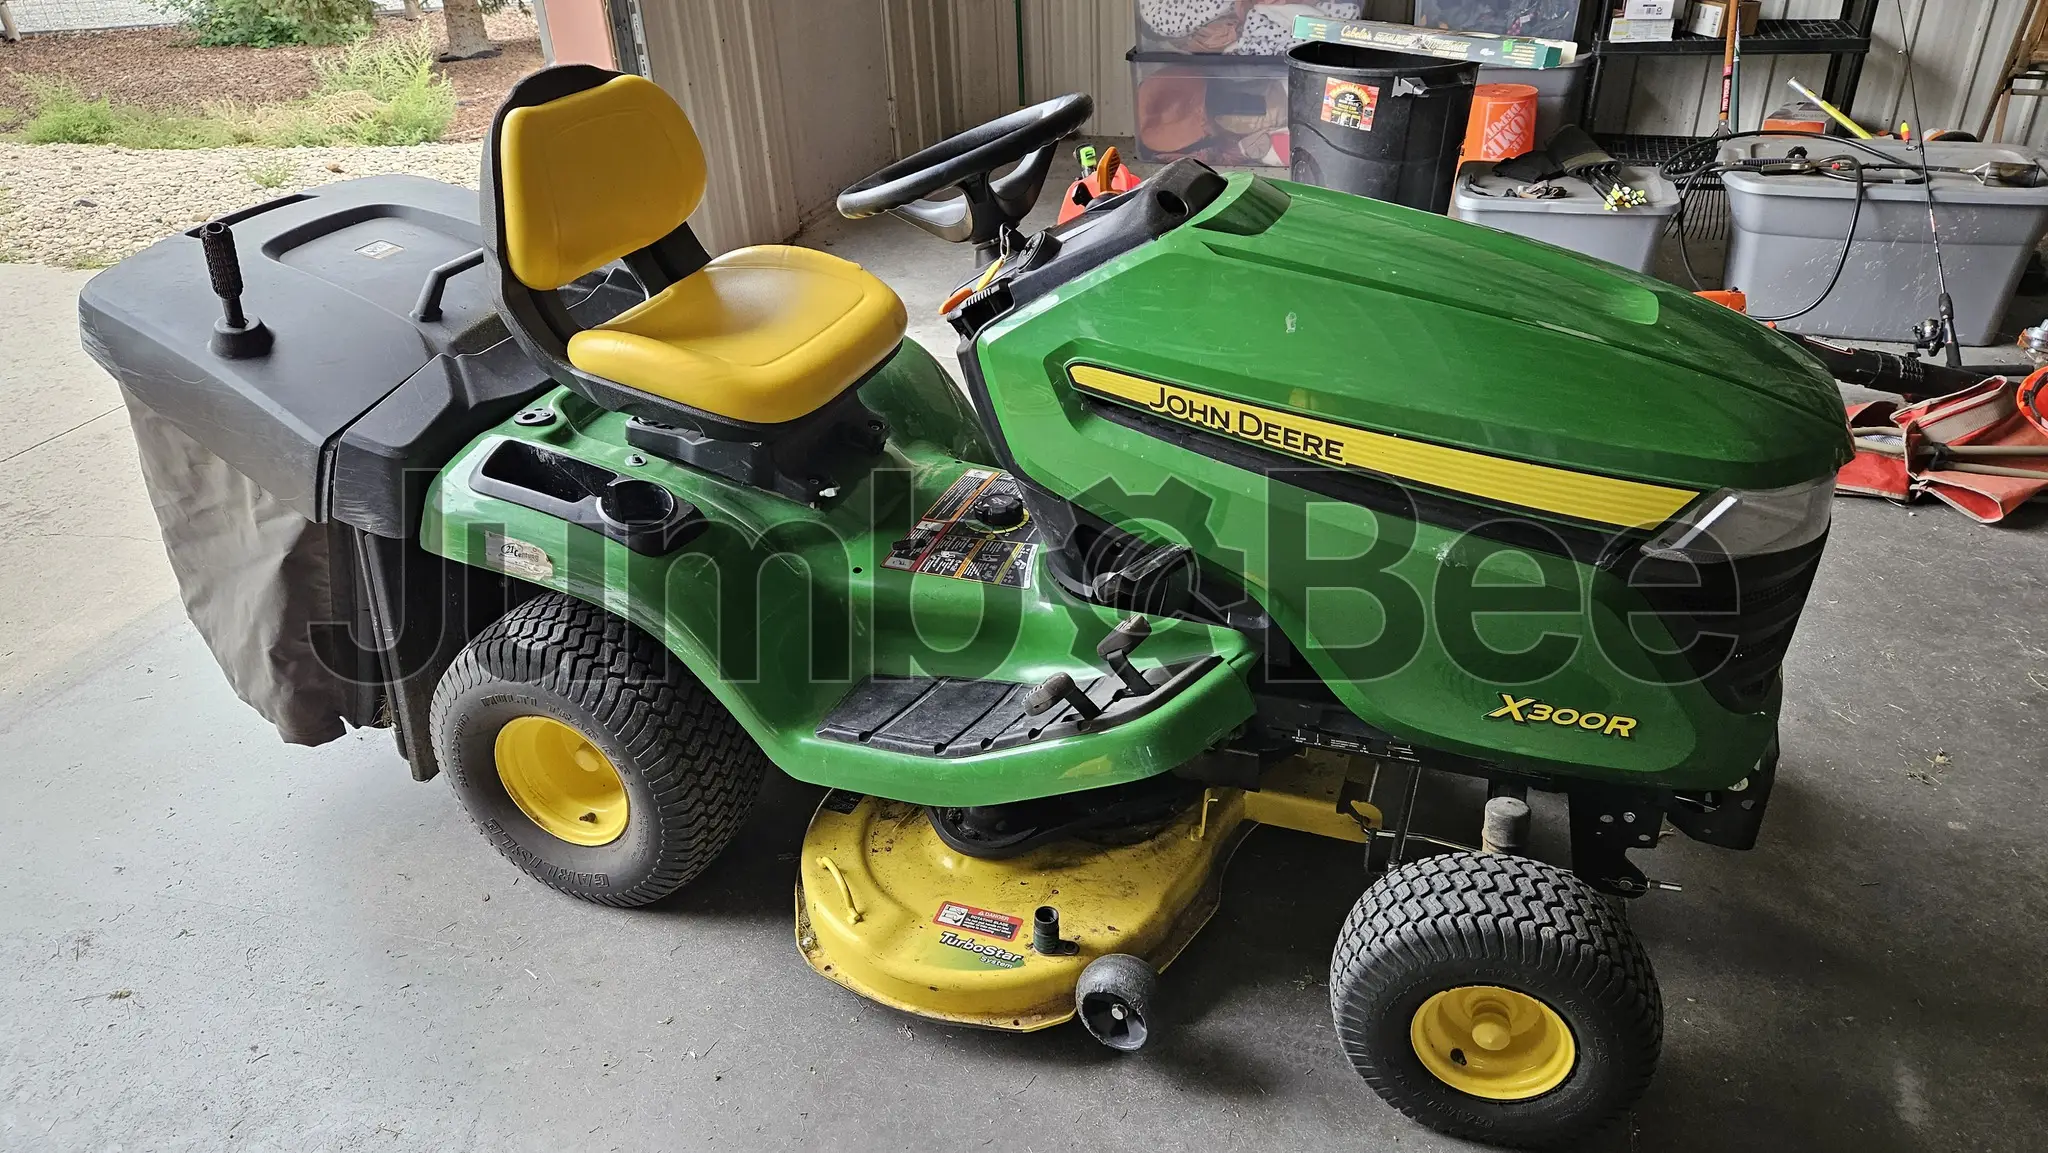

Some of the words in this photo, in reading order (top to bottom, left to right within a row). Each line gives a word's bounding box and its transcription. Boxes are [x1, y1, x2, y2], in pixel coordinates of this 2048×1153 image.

[1486, 103, 1521, 139] DEPOT
[1150, 388, 1231, 433] JOHN
[1238, 411, 1345, 464] DEERE
[1487, 692, 1638, 738] X300R
[481, 816, 611, 889] CARLISLE
[984, 912, 1010, 922] DANGER
[939, 931, 1024, 962] TurboStar
[979, 955, 1013, 969] System
